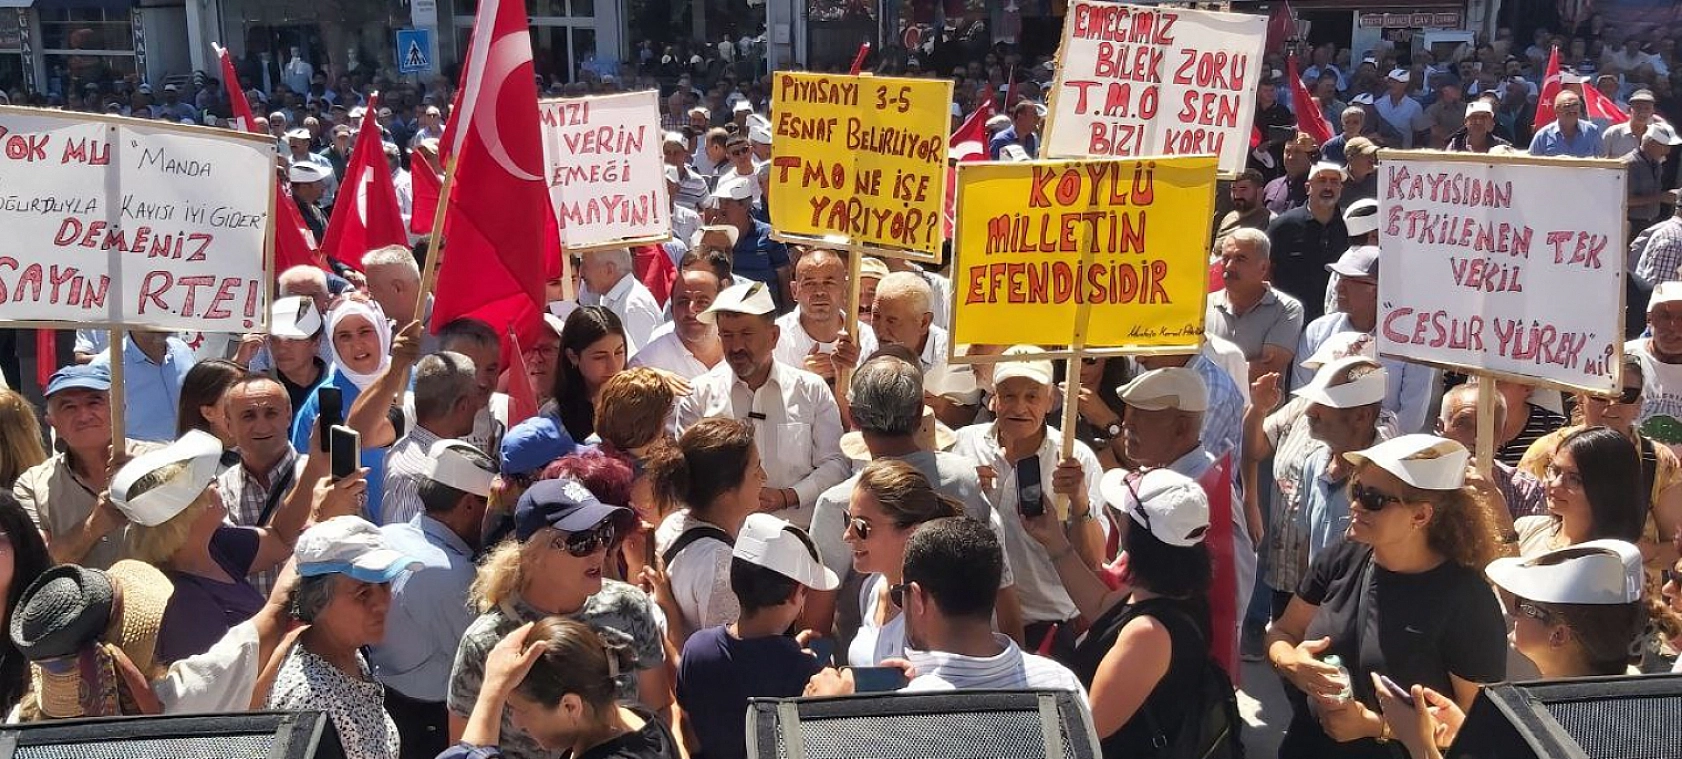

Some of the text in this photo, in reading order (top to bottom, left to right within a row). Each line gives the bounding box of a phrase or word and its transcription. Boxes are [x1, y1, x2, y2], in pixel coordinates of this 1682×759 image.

[1173, 49, 1247, 92] ZORU
[781, 75, 912, 113] PİYASAYI 3-5
[1064, 81, 1240, 128] T.M.O SEN
[563, 124, 647, 155] VERİN
[776, 112, 838, 143] ESNAF
[1163, 128, 1225, 156] KORU
[61, 137, 111, 165] MU
[773, 156, 845, 190] TMO
[854, 168, 882, 197] NE
[1028, 160, 1156, 208] KÖYLÜ
[1386, 165, 1513, 209] KAYISIDAN
[53, 216, 214, 262] DEMENİZ
[985, 209, 1146, 255] MİLLETİN
[1384, 204, 1608, 270] ETKİLENEN TEK
[964, 258, 1173, 306] EFENDİSİDİR
[1451, 256, 1523, 293] VEKİL
